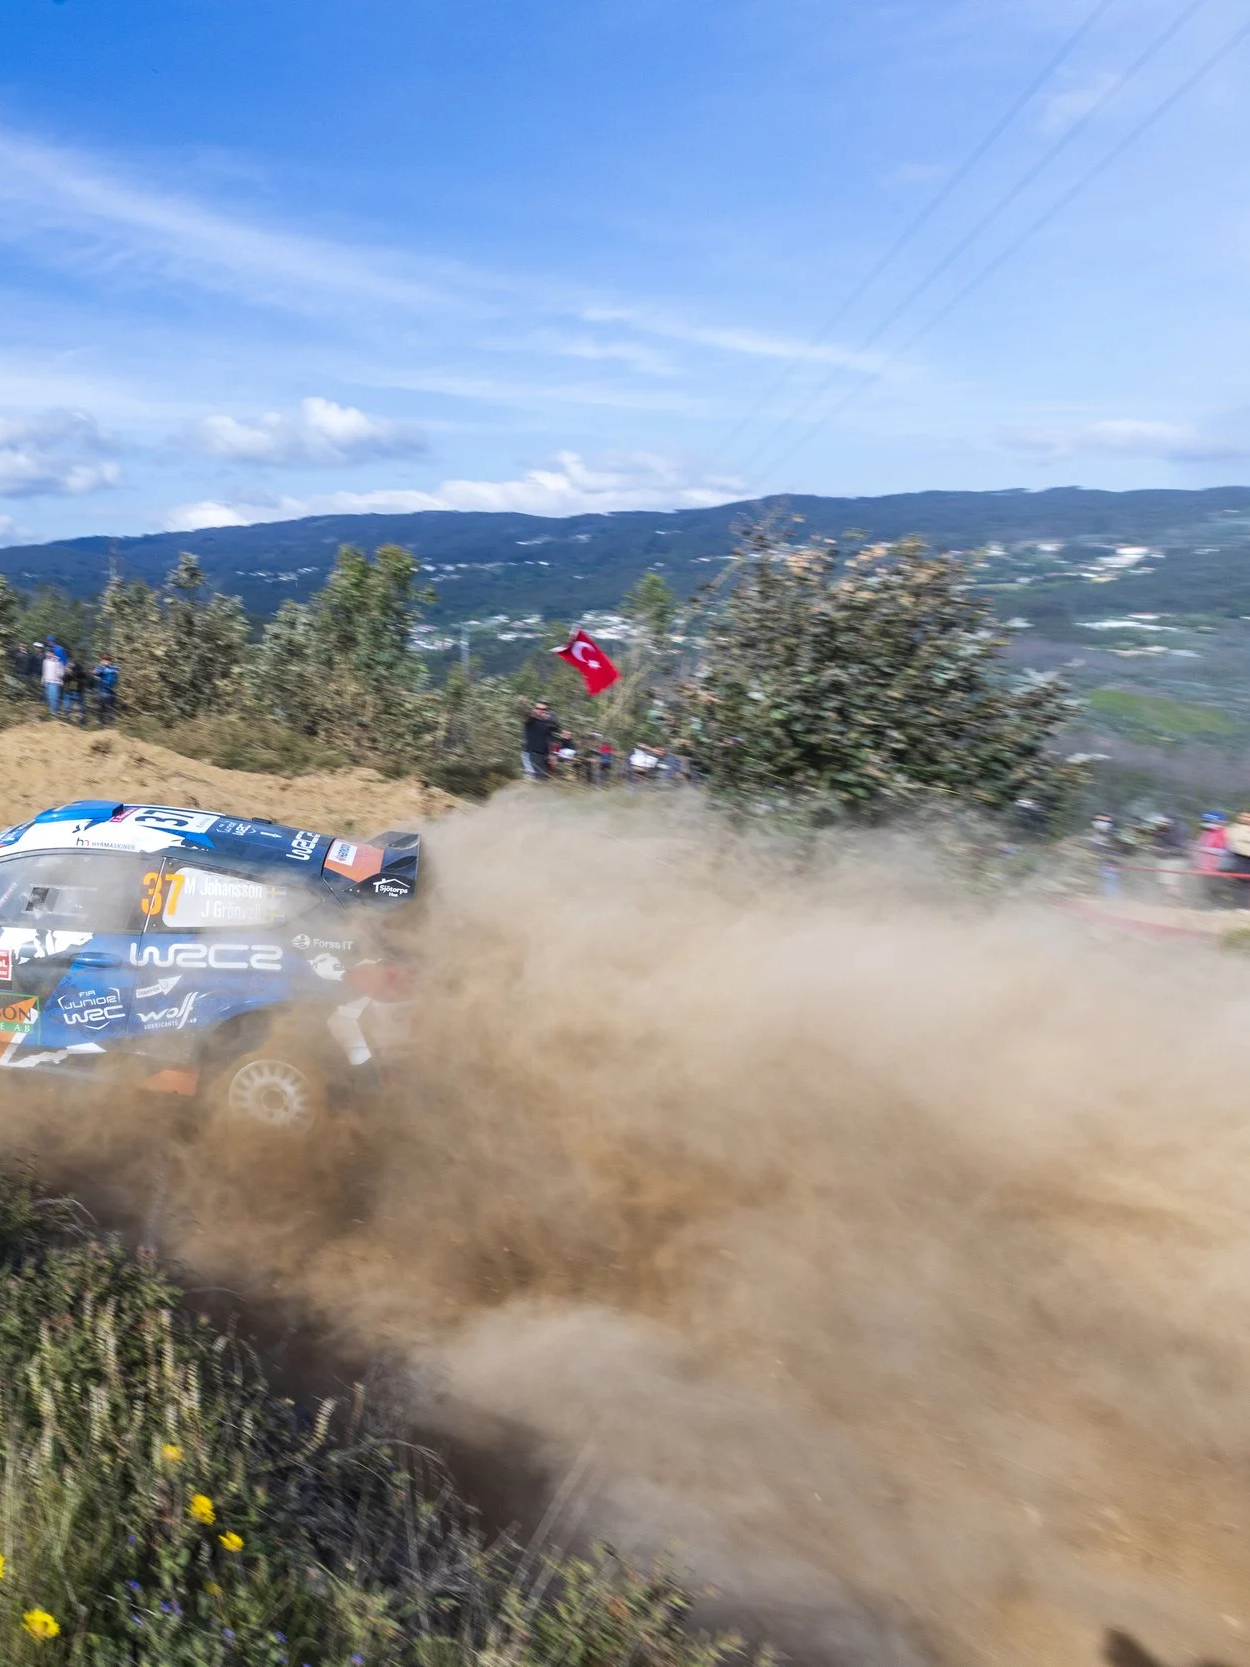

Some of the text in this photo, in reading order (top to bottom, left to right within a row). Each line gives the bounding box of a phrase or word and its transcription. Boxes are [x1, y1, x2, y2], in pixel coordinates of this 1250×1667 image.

[134, 809, 195, 827] 37
[141, 871, 185, 916] 37
[184, 877, 263, 899] M Johansson
[379, 884, 409, 895] Sjötorps
[200, 900, 262, 921] J Grönvall
[312, 938, 354, 950] Forss IT
[129, 942, 284, 971] WRC2
[64, 995, 118, 1010] JUNIOR
[78, 989, 96, 998] FIA
[63, 1004, 126, 1025] WRC
[136, 991, 199, 1030] wolf
[13, 1023, 31, 1033] AB
[143, 1021, 178, 1030] LUBRICANTS
